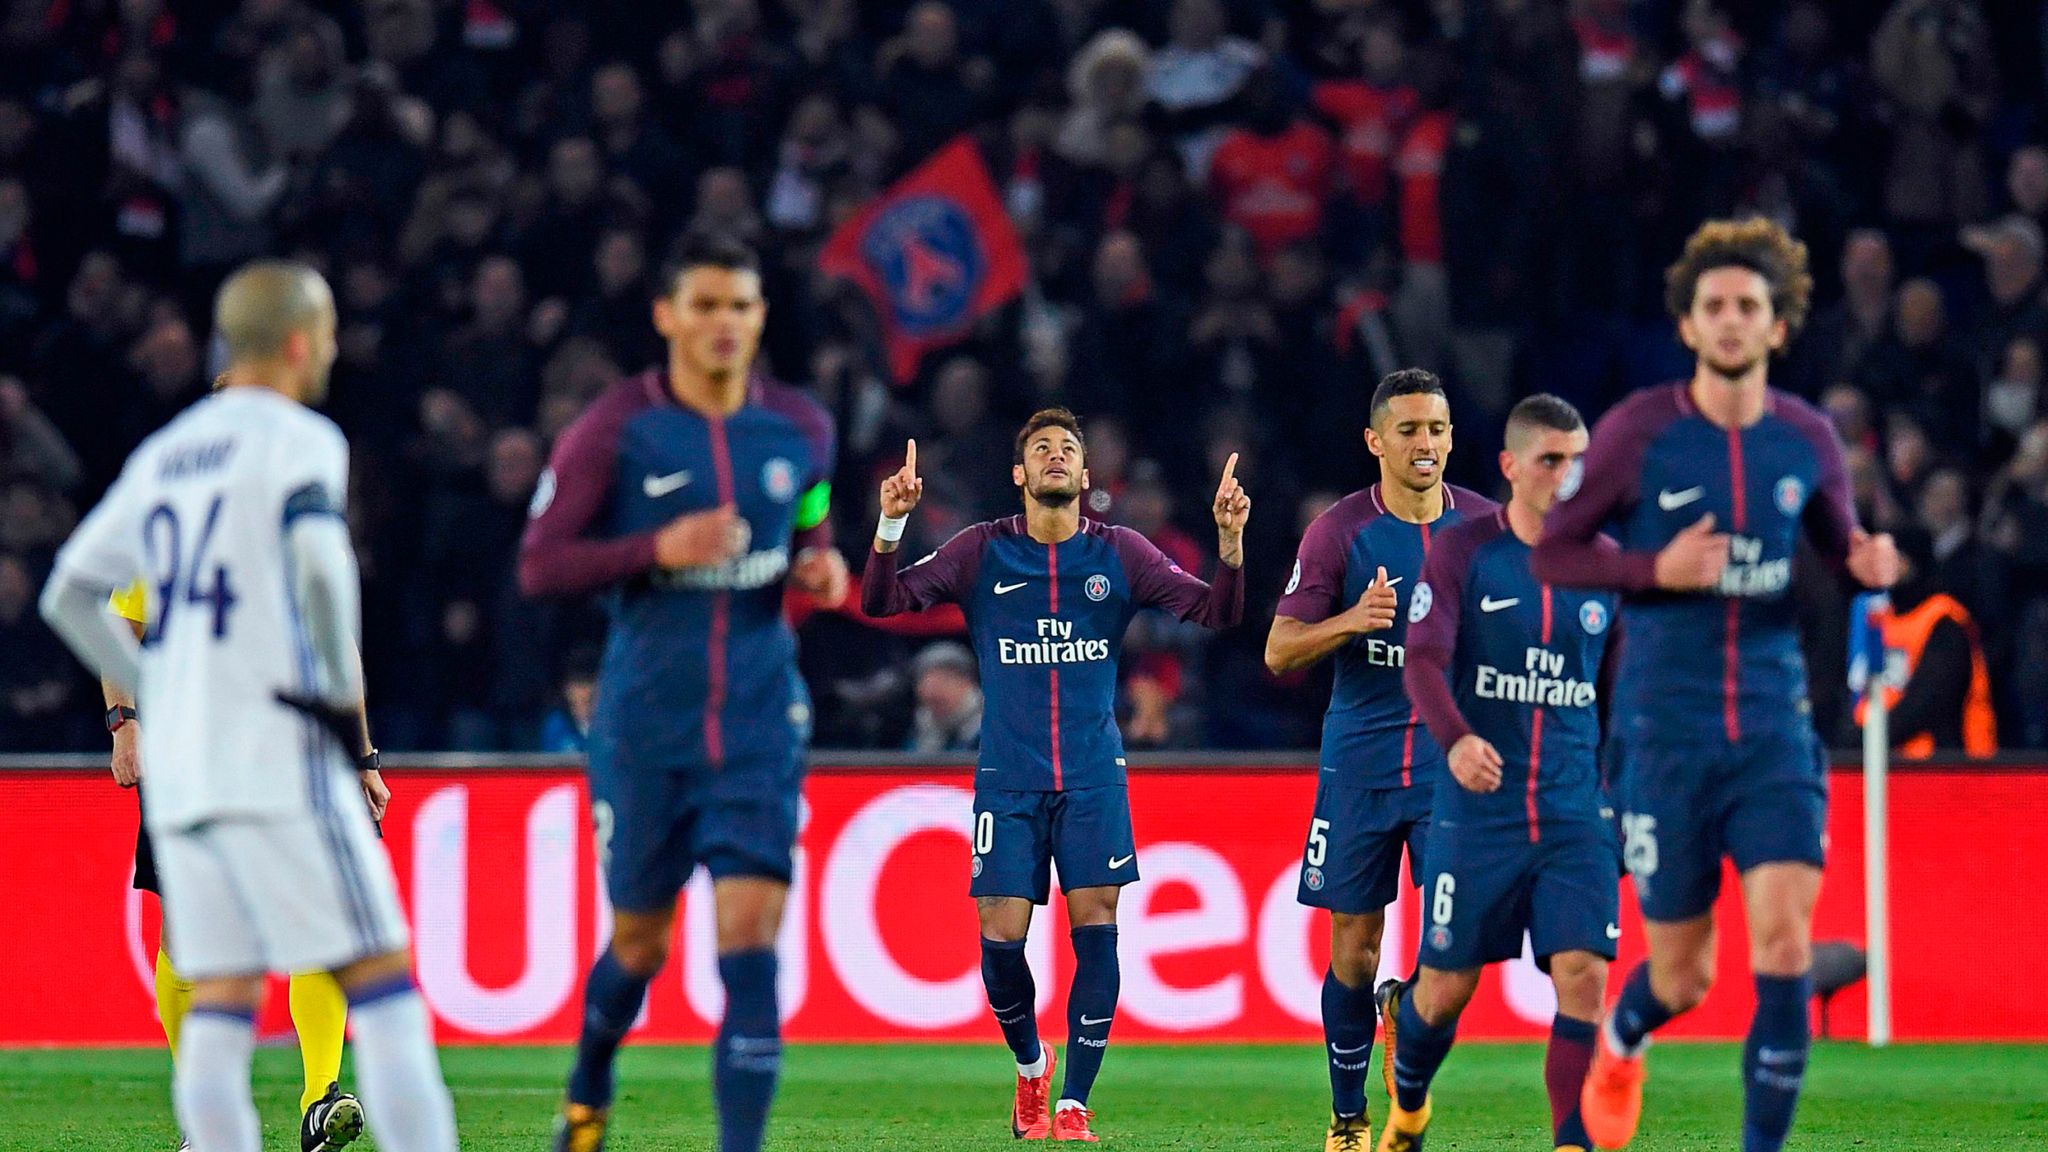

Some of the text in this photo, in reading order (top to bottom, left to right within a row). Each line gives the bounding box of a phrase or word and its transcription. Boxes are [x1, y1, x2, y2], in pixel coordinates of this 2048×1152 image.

[142, 496, 238, 649] 94
[998, 637, 1109, 664] Emirates
[1037, 618, 1073, 640] Fly
[1524, 646, 1566, 677] Fly
[1474, 664, 1597, 709] Emirate
[1307, 817, 1331, 867] 5
[1432, 873, 1456, 926] 6
